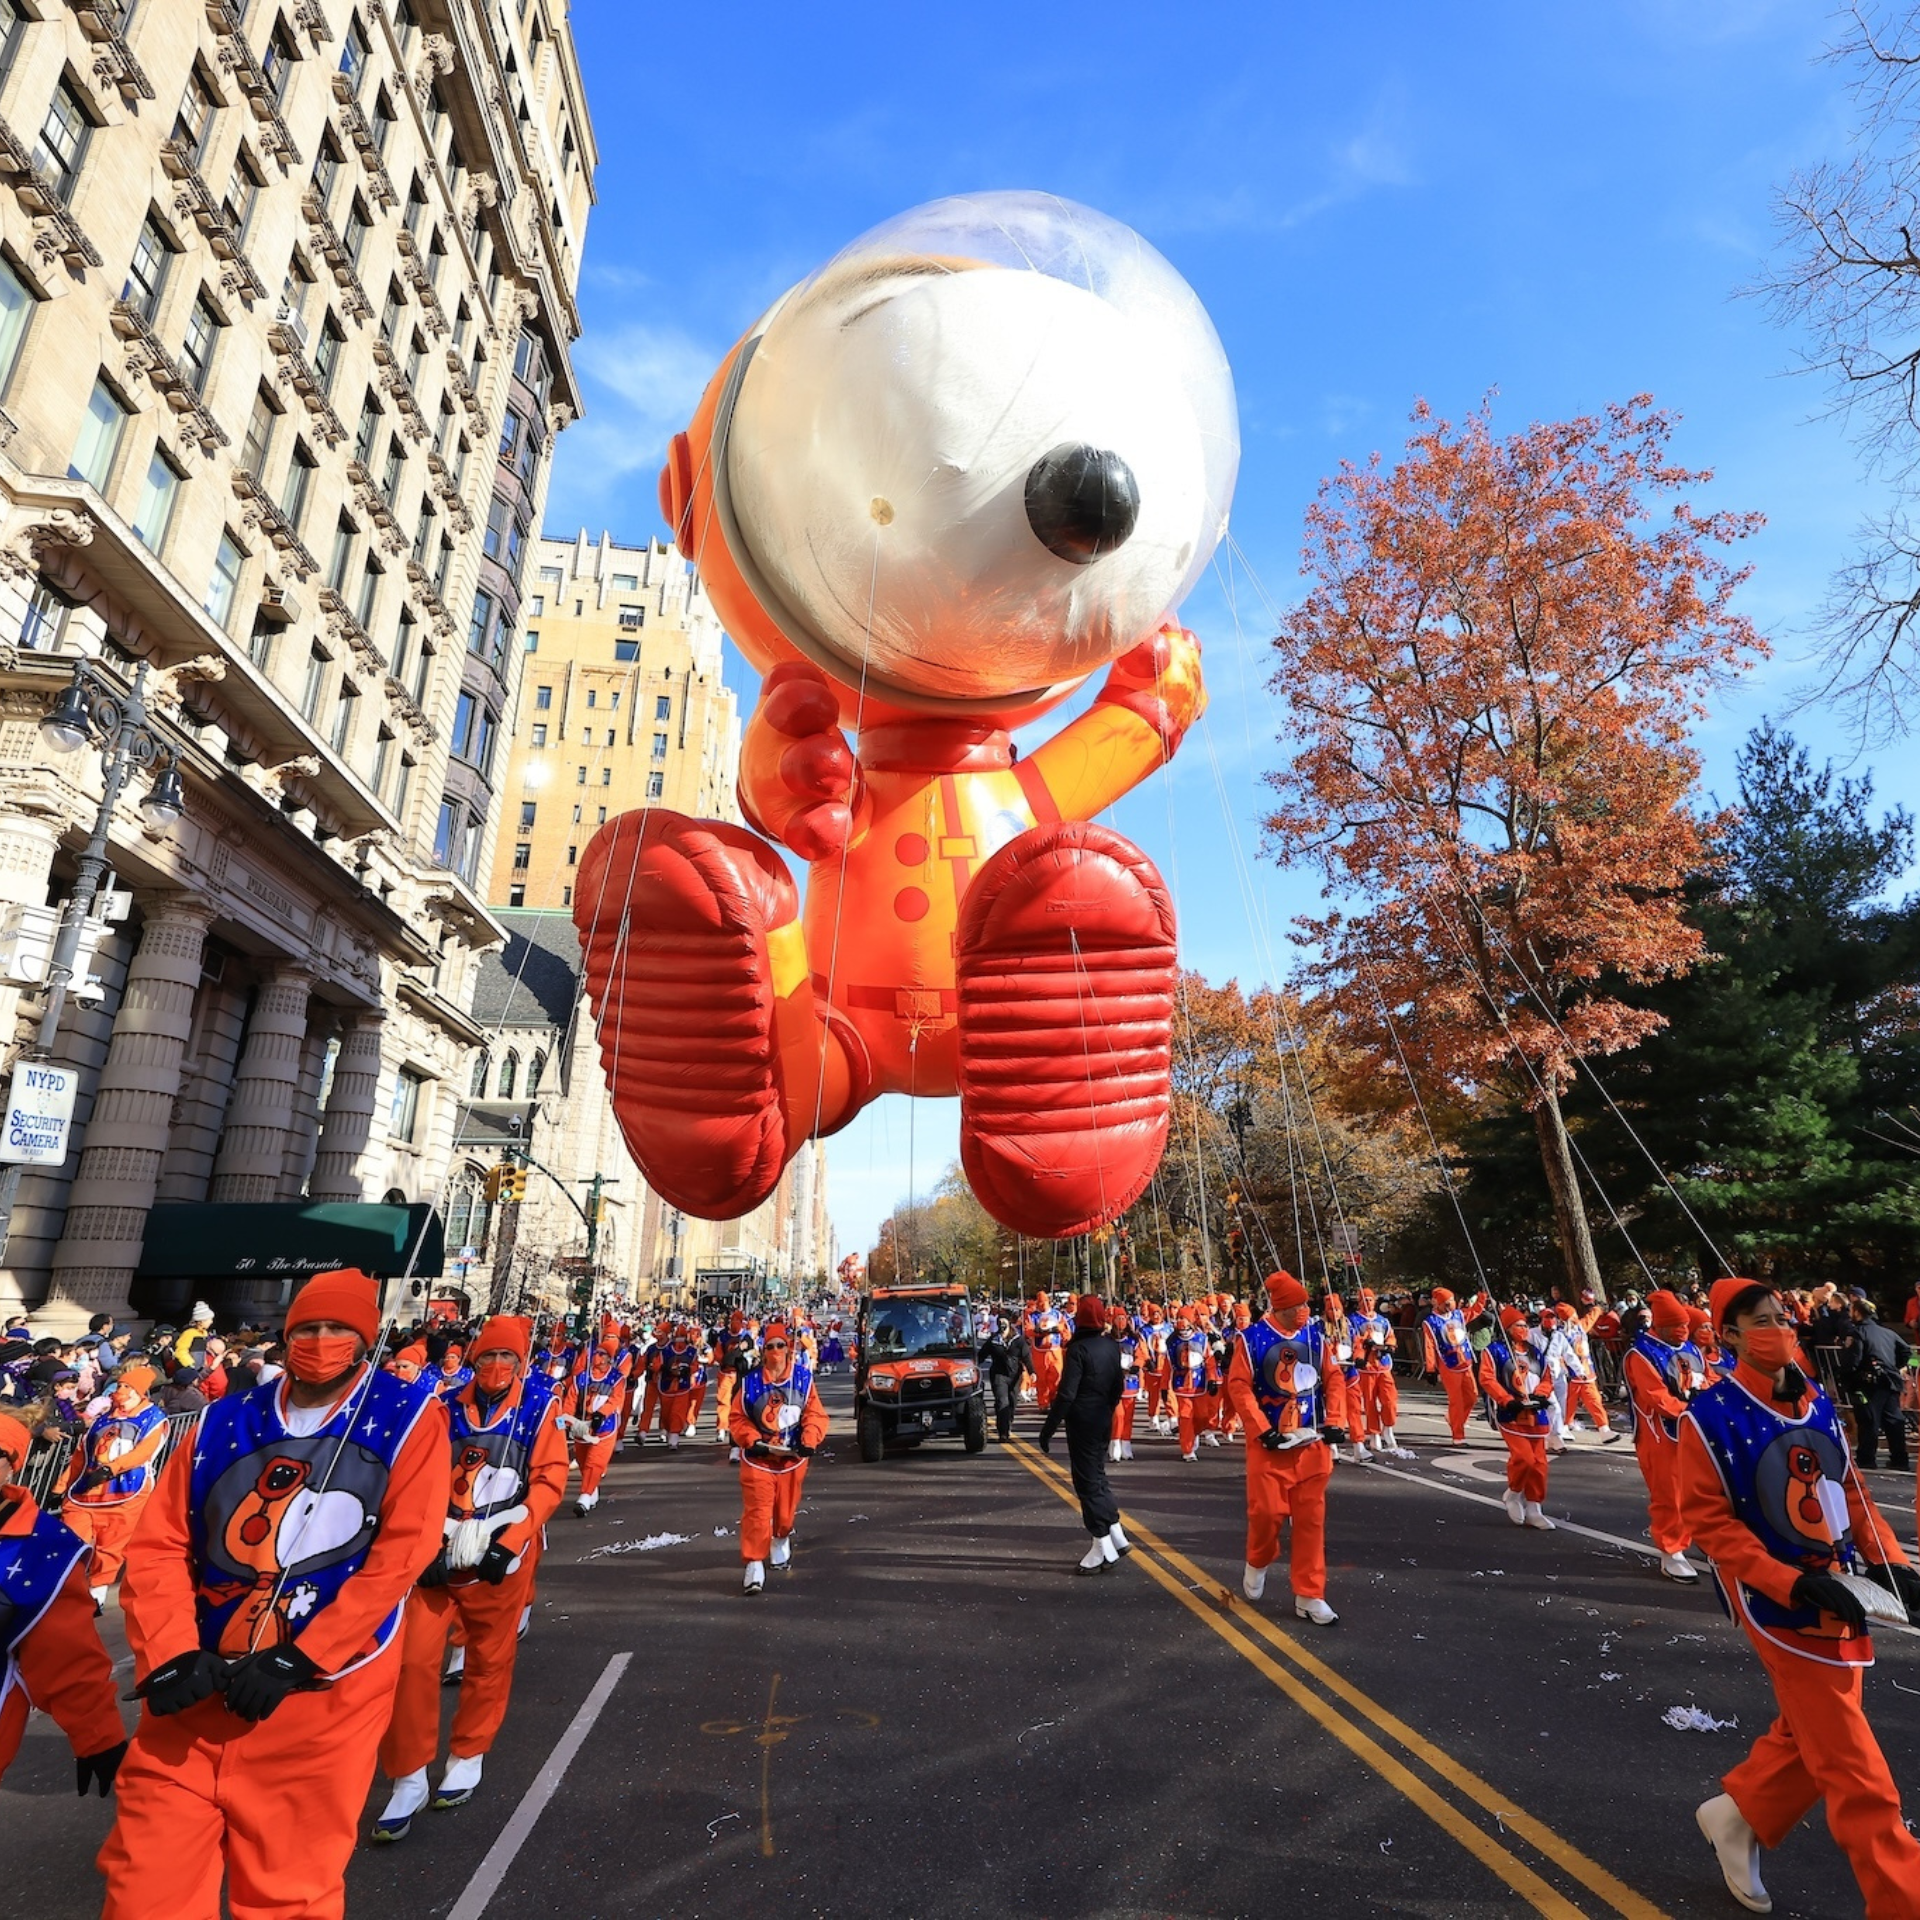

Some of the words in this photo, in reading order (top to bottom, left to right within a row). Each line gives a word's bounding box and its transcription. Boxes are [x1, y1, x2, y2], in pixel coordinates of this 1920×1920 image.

[26, 1070, 65, 1091] NYPD
[11, 1109, 65, 1131] SECURITY
[10, 1128, 58, 1148] CAMERA
[235, 1258, 255, 1270] 50
[266, 1257, 291, 1270] The
[291, 1257, 343, 1270] Prasada
